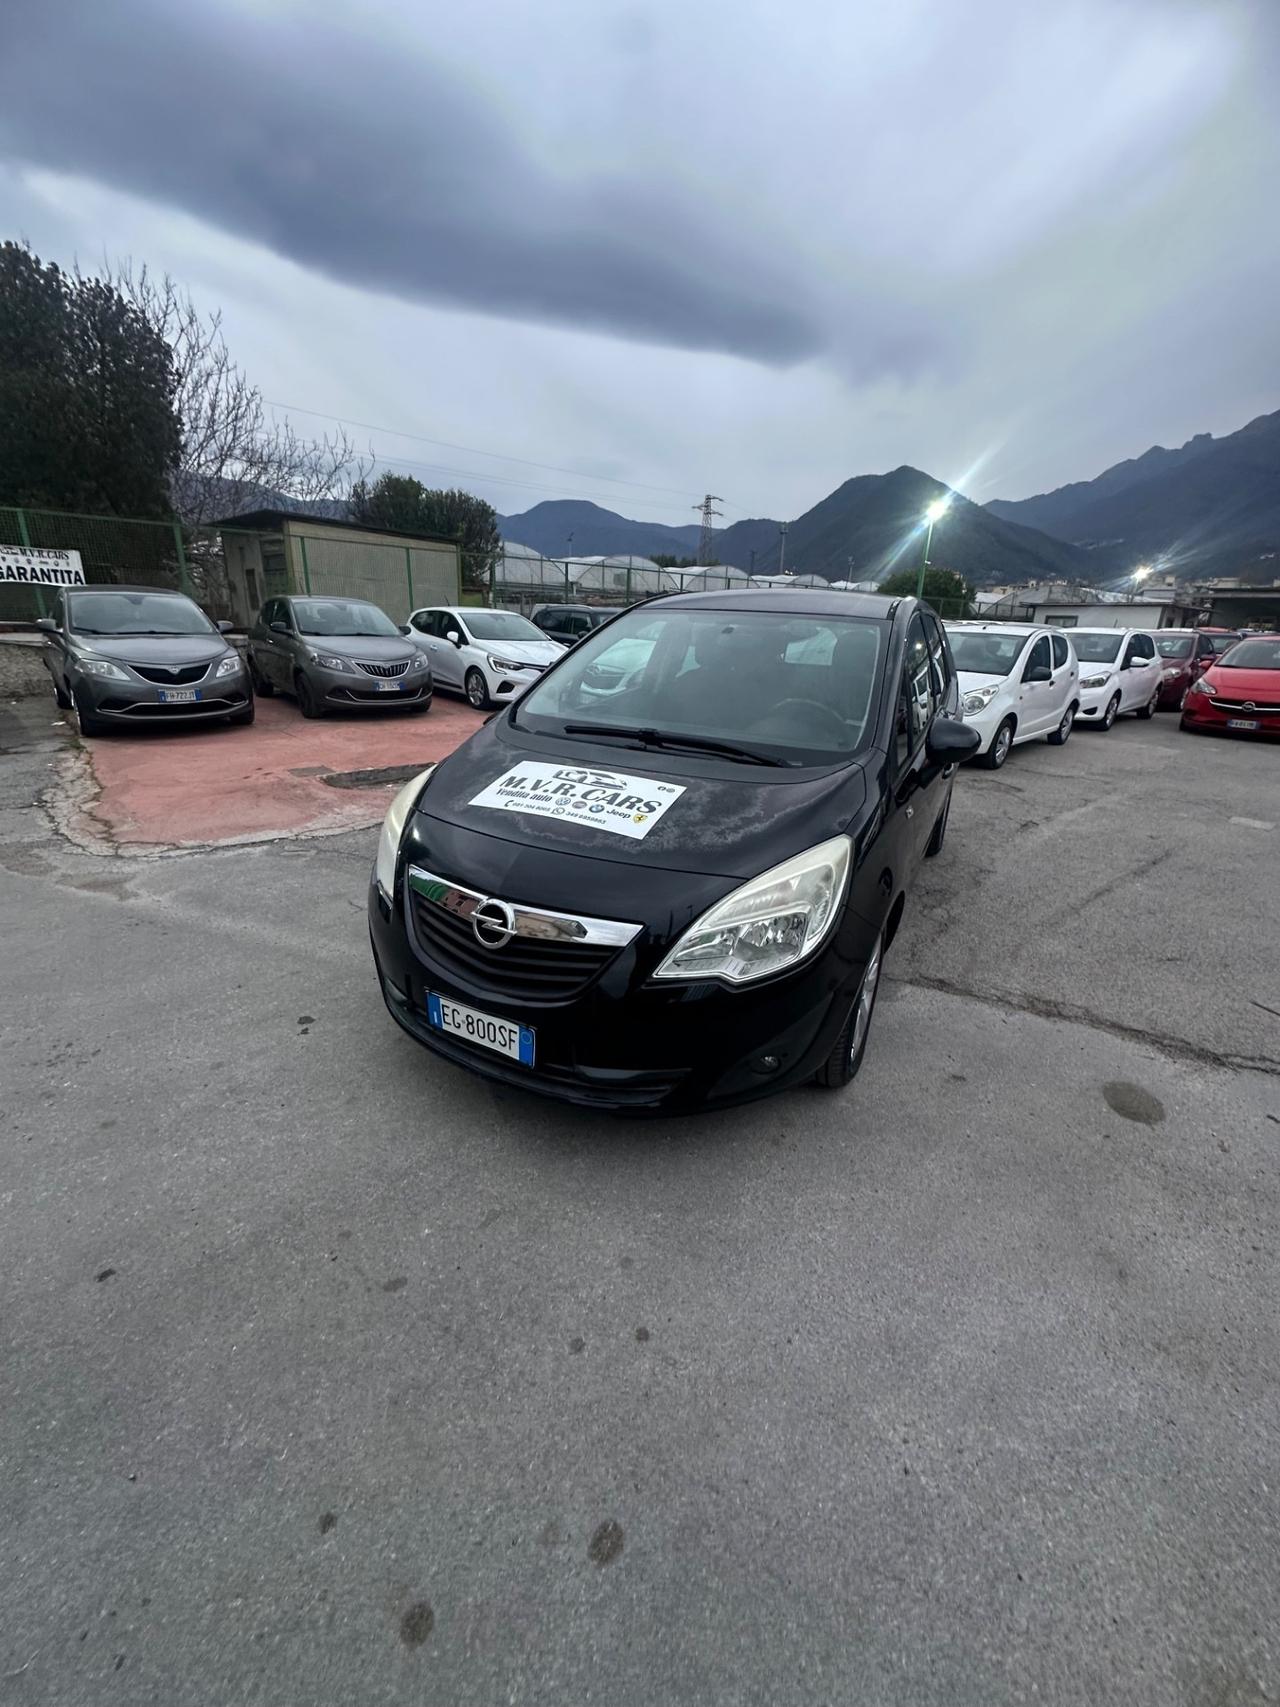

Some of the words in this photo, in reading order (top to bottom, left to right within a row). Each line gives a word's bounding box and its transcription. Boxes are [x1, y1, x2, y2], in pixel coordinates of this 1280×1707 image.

[496, 788, 530, 799] Vendita
[529, 794, 553, 802] auto
[606, 808, 631, 819] Jeep
